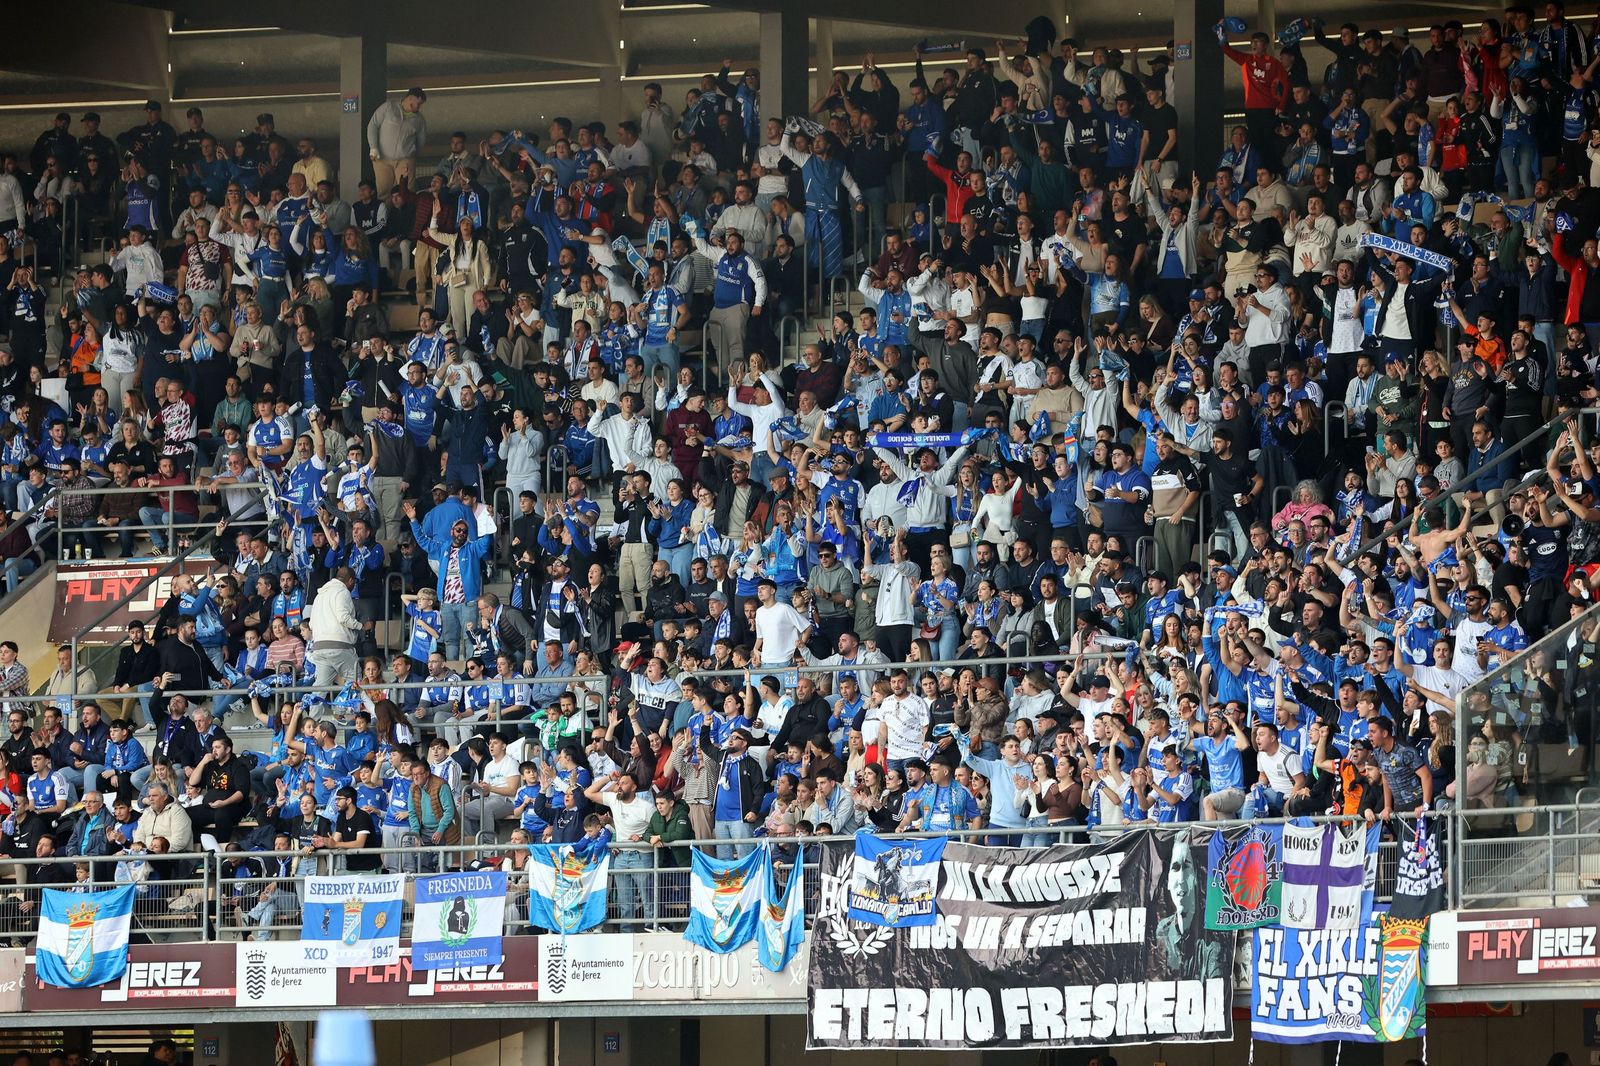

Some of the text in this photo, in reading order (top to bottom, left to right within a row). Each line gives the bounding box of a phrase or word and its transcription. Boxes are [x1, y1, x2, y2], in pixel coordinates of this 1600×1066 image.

[343, 102, 357, 111] 314
[1373, 236, 1453, 267] EL XIKLE FANS
[67, 578, 142, 603] PLAY
[785, 675, 798, 685] 212
[490, 687, 502, 697] 213
[1284, 834, 1320, 851] HOOLS
[428, 875, 493, 896] FRESNEDA
[941, 852, 1126, 903] NI LA MUERTE
[309, 880, 400, 896] SHERRY FAMILY
[910, 907, 1147, 949] NOS VA A SEPARAR
[304, 947, 329, 960] XCD
[371, 945, 394, 959] 1947
[1258, 928, 1381, 978] EL XIKLE
[1468, 930, 1528, 961] PLAY
[423, 950, 454, 962] SIEMPRE
[454, 948, 488, 959] PRESENTE
[271, 965, 327, 976] Ayuntamiento
[571, 959, 625, 969] Ayuntamiento
[571, 970, 602, 981] de Jerez
[632, 949, 740, 996] zcampo
[101, 961, 201, 1002] JEREZ
[271, 977, 303, 987] de Jerez
[1257, 974, 1363, 1021] FANS
[813, 978, 1226, 1042] ETERNO FRESNEDA
[203, 1046, 216, 1055] 112
[604, 1040, 617, 1050] 112
